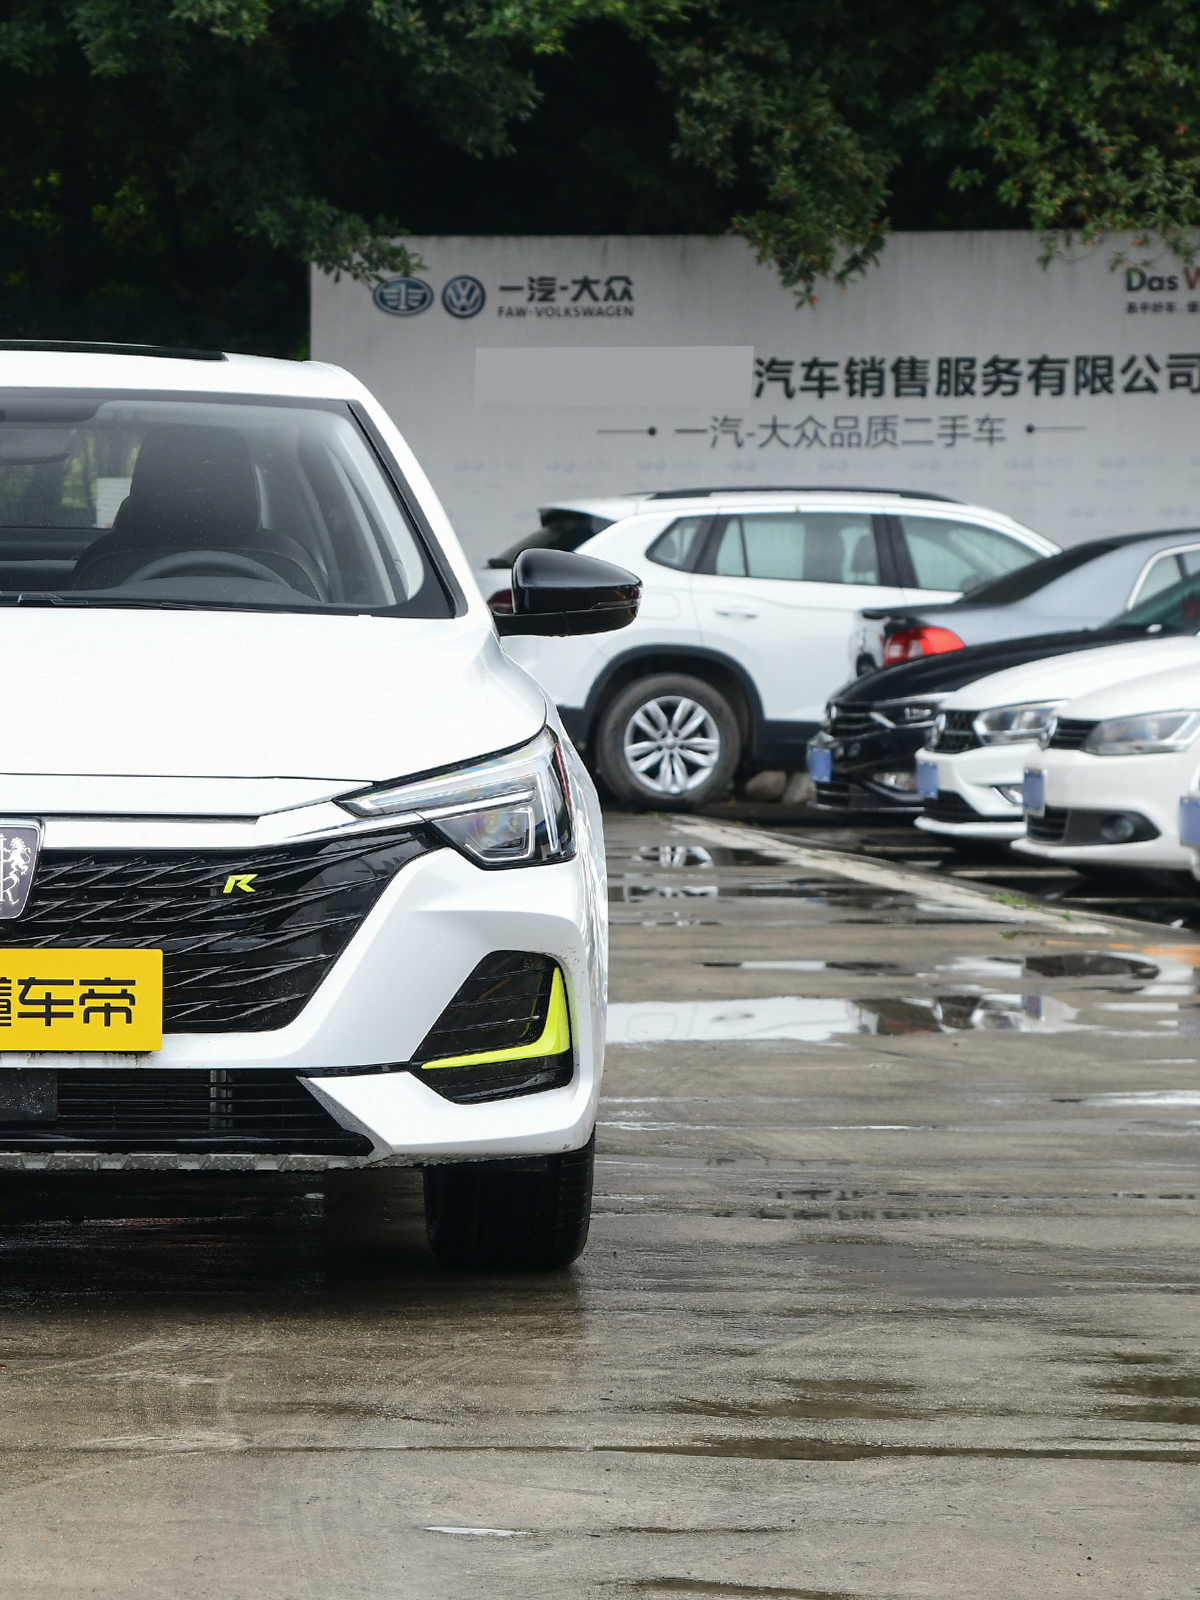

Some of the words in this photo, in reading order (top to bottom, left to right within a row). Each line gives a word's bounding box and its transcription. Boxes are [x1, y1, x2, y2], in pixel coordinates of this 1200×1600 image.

[498, 275, 634, 302] 一汽-大众
[1126, 267, 1178, 291] Das
[498, 304, 635, 318] FAW-VOLKSWAGEN
[754, 352, 1200, 400] 汽车销售服务有限公司
[674, 413, 1008, 449] 一汽-大众品质二手车
[222, 873, 259, 894] R
